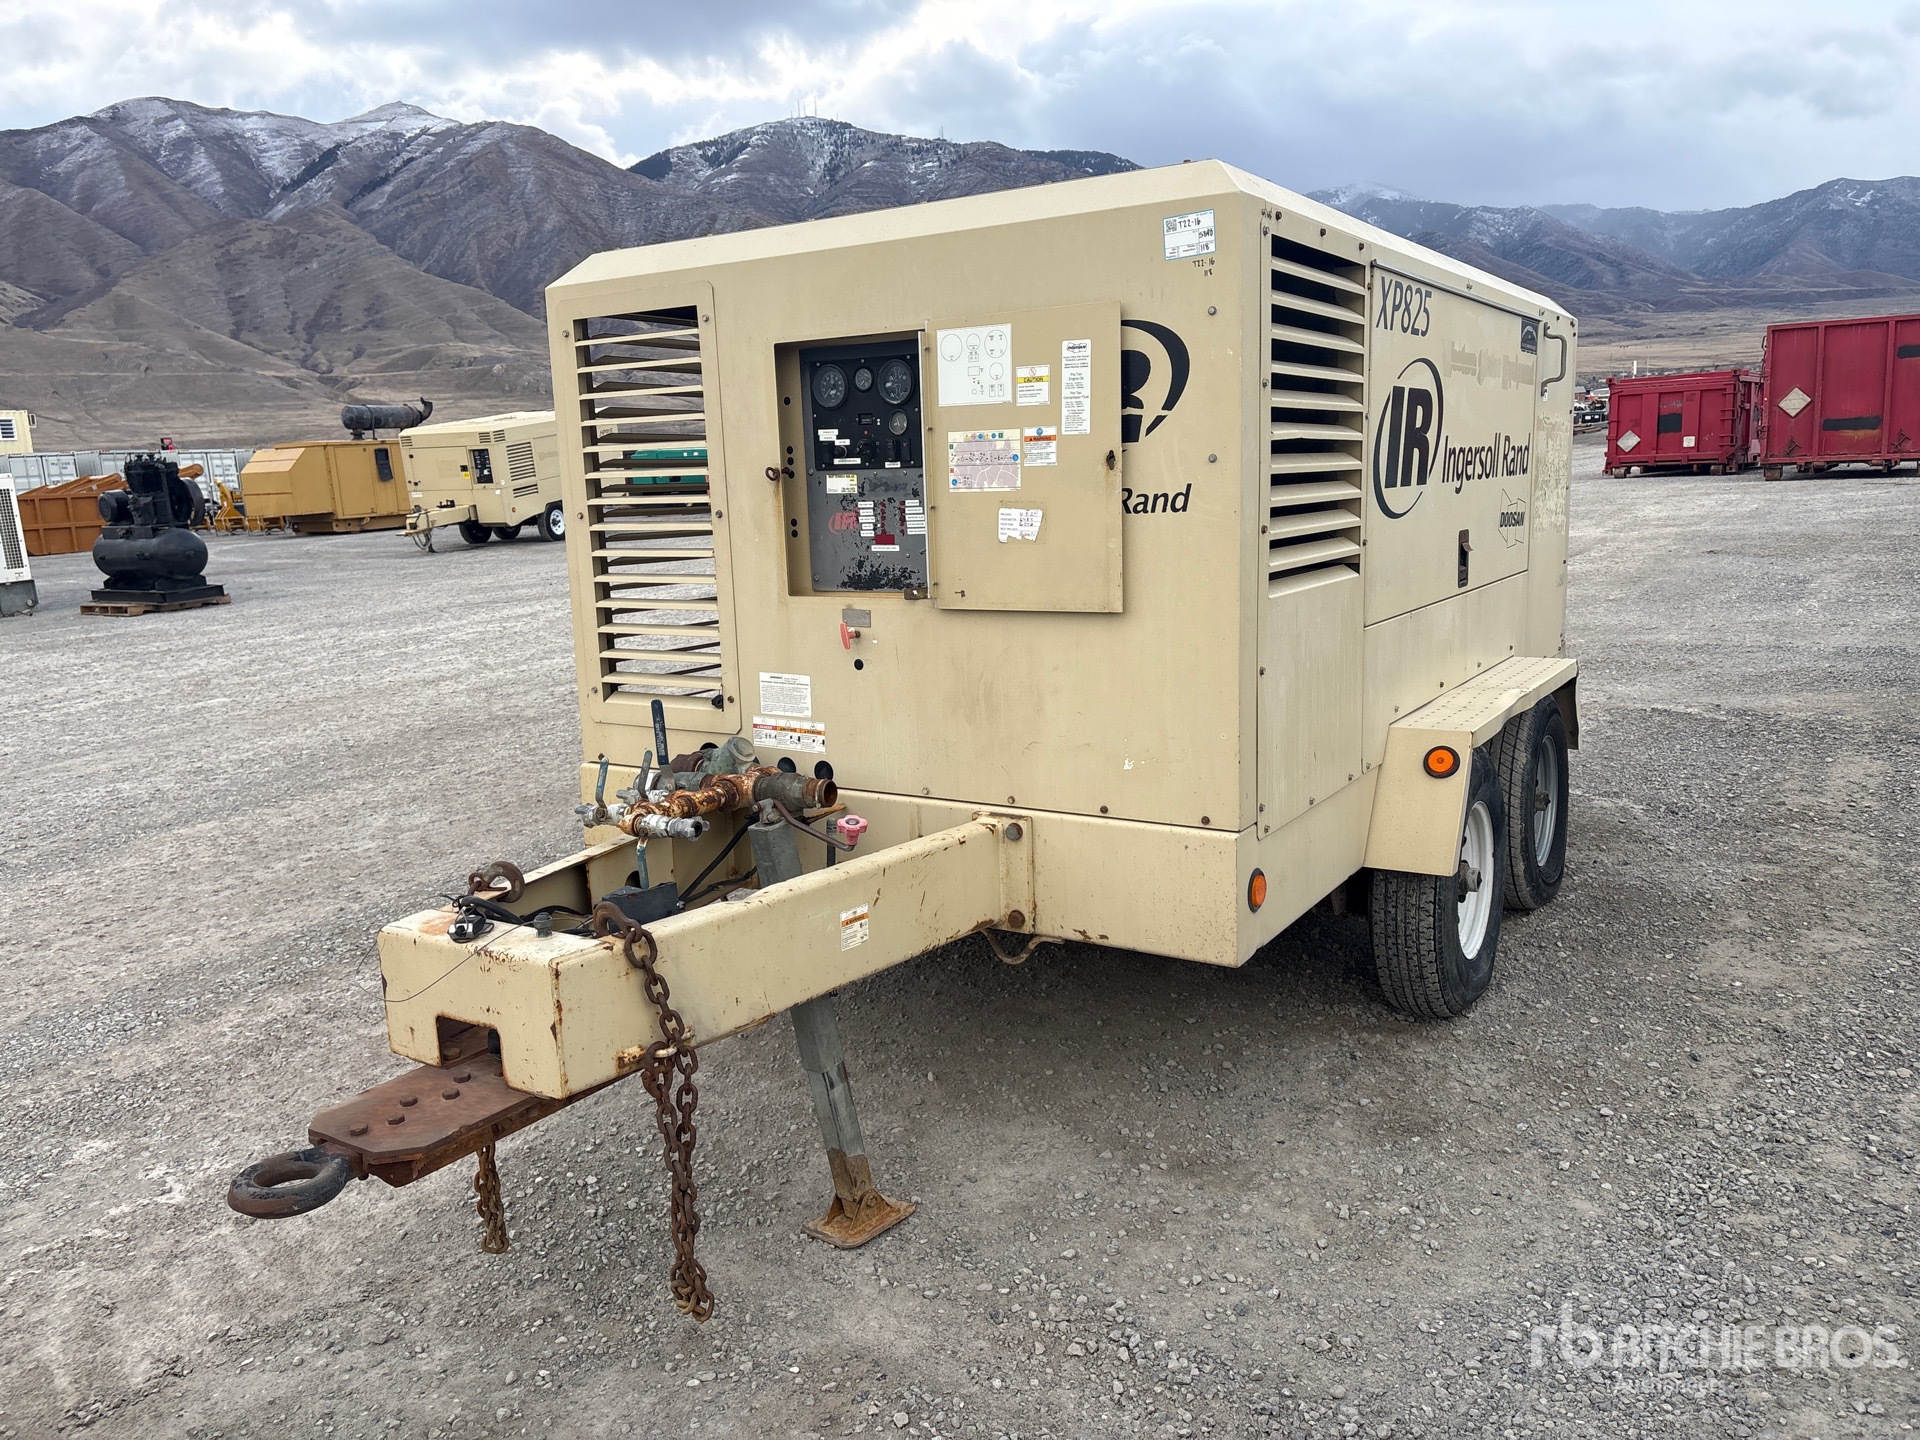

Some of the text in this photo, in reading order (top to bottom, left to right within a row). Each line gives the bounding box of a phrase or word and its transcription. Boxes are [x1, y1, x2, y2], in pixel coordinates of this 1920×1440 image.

[1376, 276, 1432, 337] XP825
[1384, 385, 1433, 489] IR
[1441, 432, 1531, 494] Ingersoll Rand
[1499, 510, 1525, 527] DOOSAN
